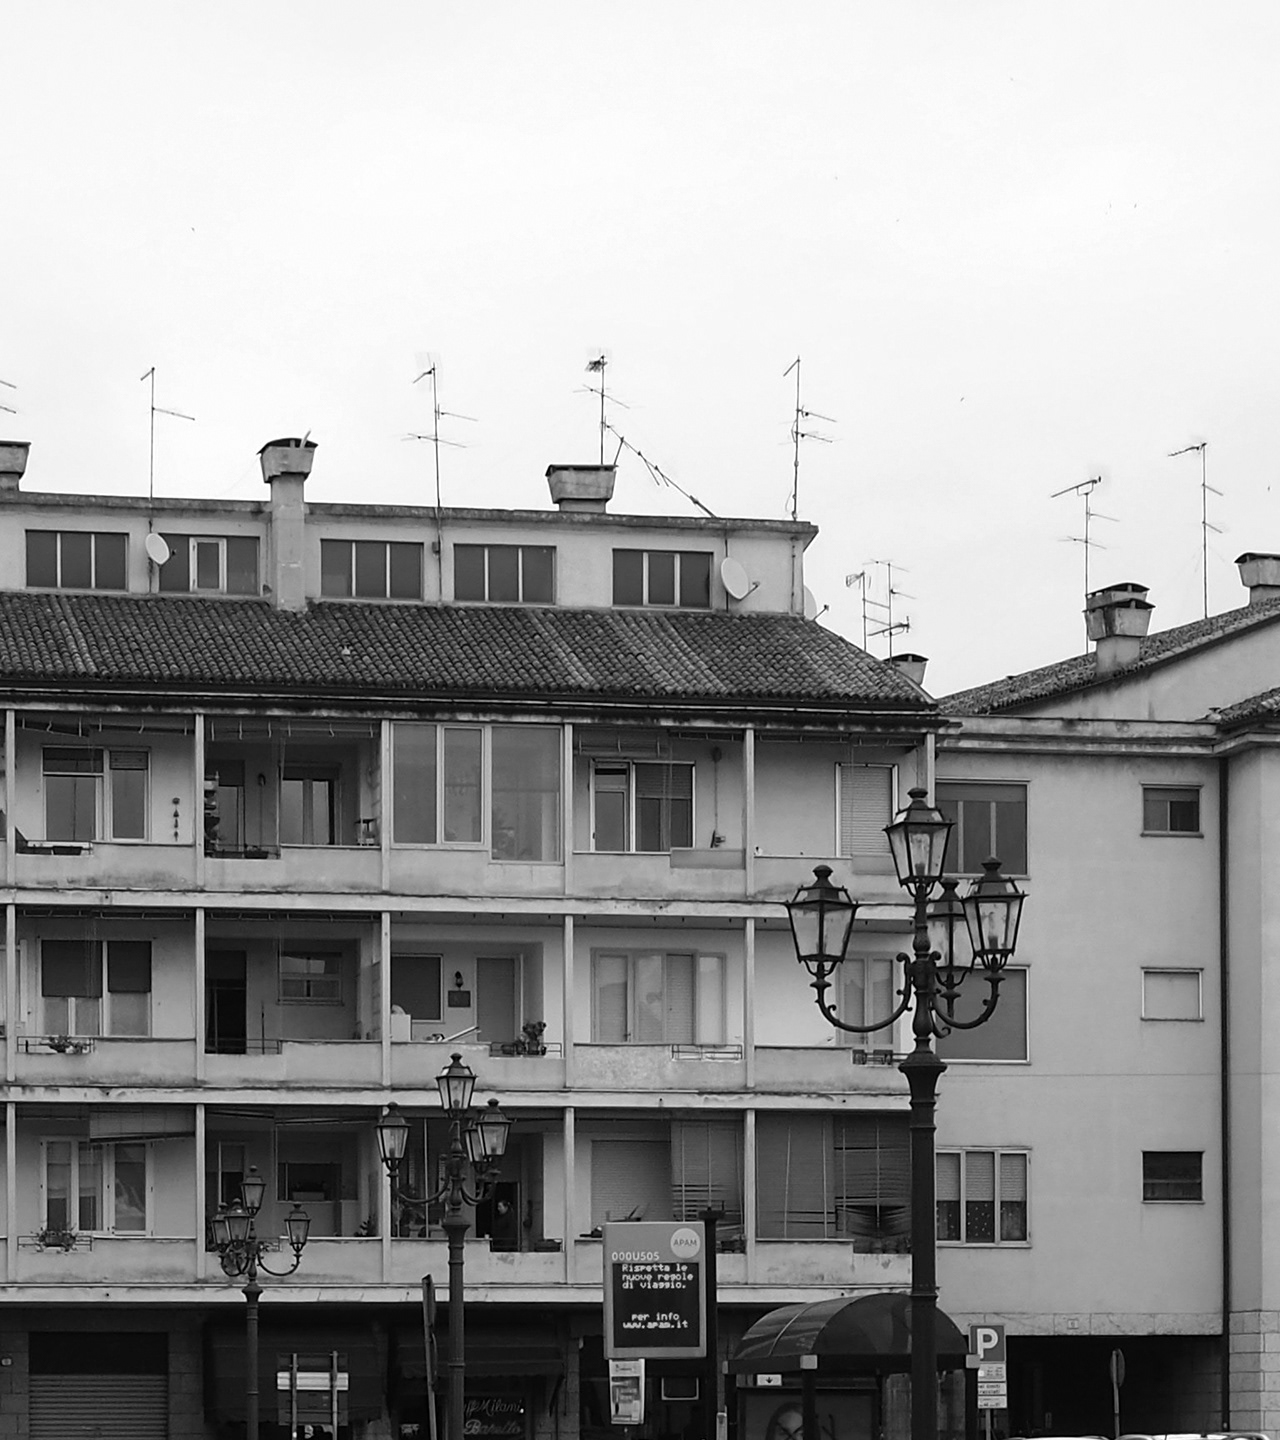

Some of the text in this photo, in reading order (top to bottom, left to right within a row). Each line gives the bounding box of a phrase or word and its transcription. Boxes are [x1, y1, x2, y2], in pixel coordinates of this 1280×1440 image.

[673, 1239, 697, 1247] APAM
[622, 1263, 688, 1272] Rispetta le
[657, 1272, 693, 1281] regole
[622, 1281, 686, 1289] di viaggio.
[631, 1312, 680, 1321] per info
[622, 1320, 688, 1329] www.apam.it
[977, 1328, 998, 1359] P
